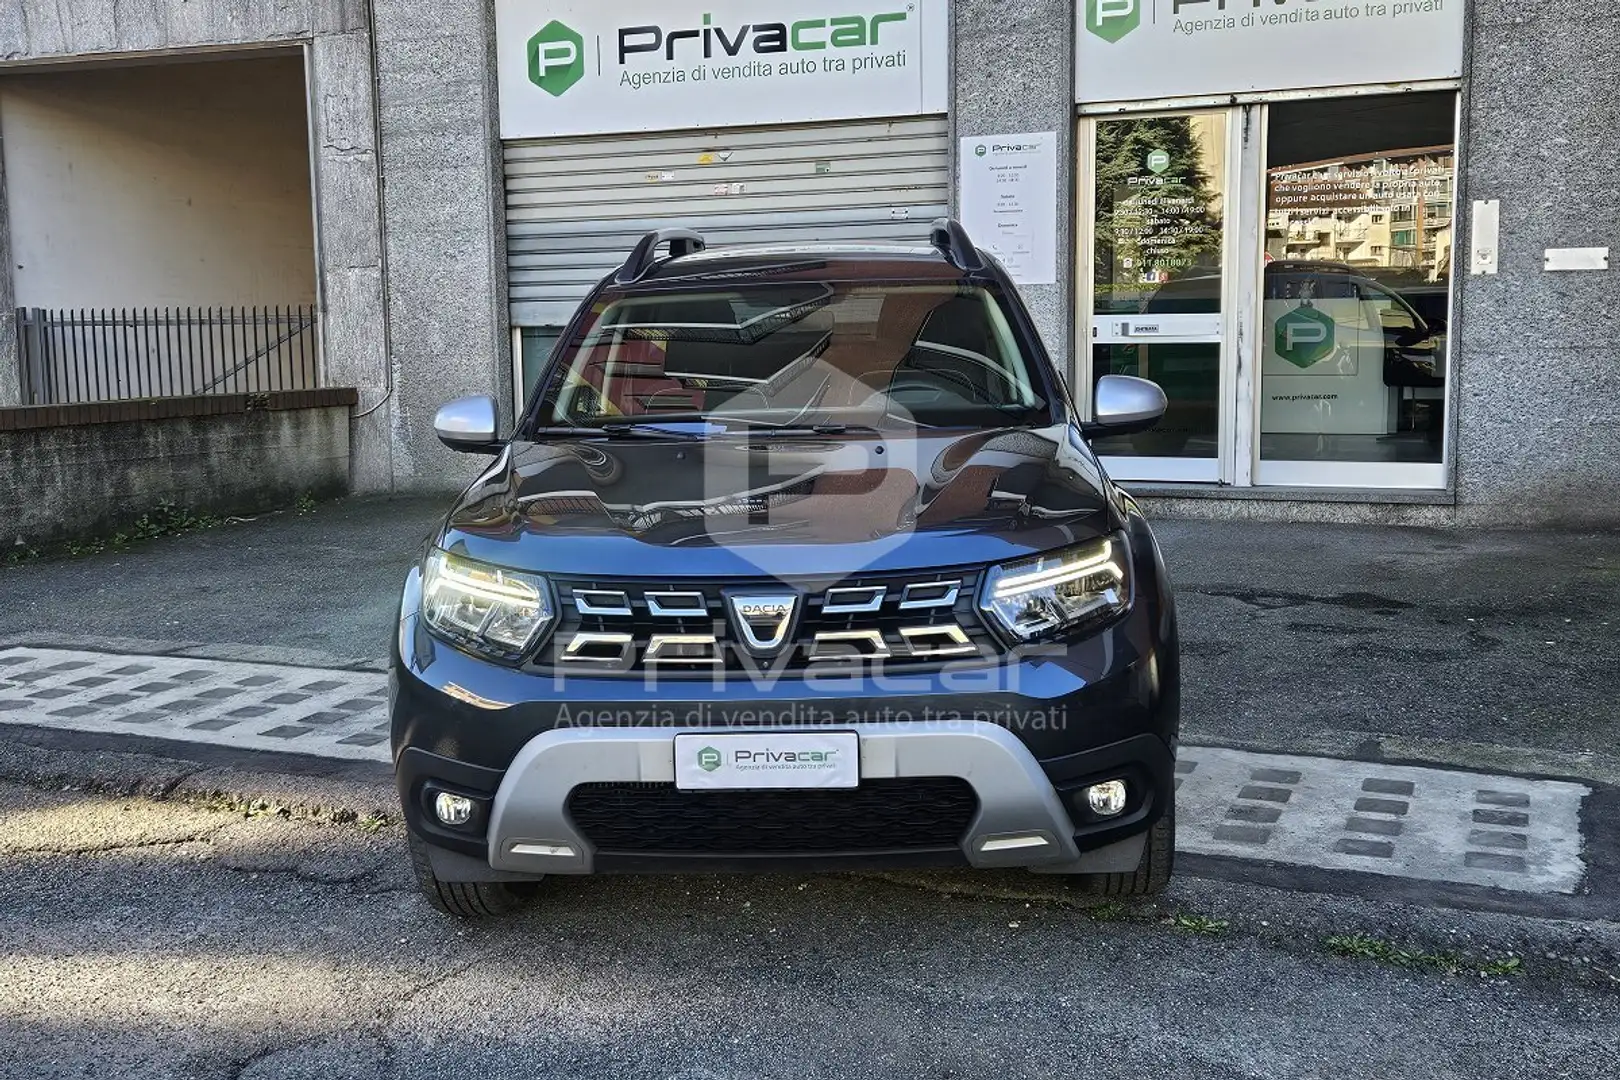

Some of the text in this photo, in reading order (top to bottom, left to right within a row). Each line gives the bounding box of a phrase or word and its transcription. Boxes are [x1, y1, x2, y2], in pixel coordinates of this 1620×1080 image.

[1173, 14, 1236, 36] Agenzia
[1240, 12, 1254, 28] di
[1259, 7, 1320, 26] vendita
[1322, 5, 1360, 21] auto
[1365, 2, 1387, 17] tra
[1392, 0, 1444, 18] privati
[618, 12, 907, 65] Privacar
[619, 49, 907, 90] Agenzia di vendita auto tra privati
[1127, 175, 1187, 185] Privacar
[1274, 182, 1291, 192] che
[1292, 182, 1331, 193] vogliono
[1275, 195, 1308, 206] oppure
[1310, 191, 1357, 203] acquistare
[743, 604, 786, 613] DACIA
[735, 748, 837, 763] Privacar
